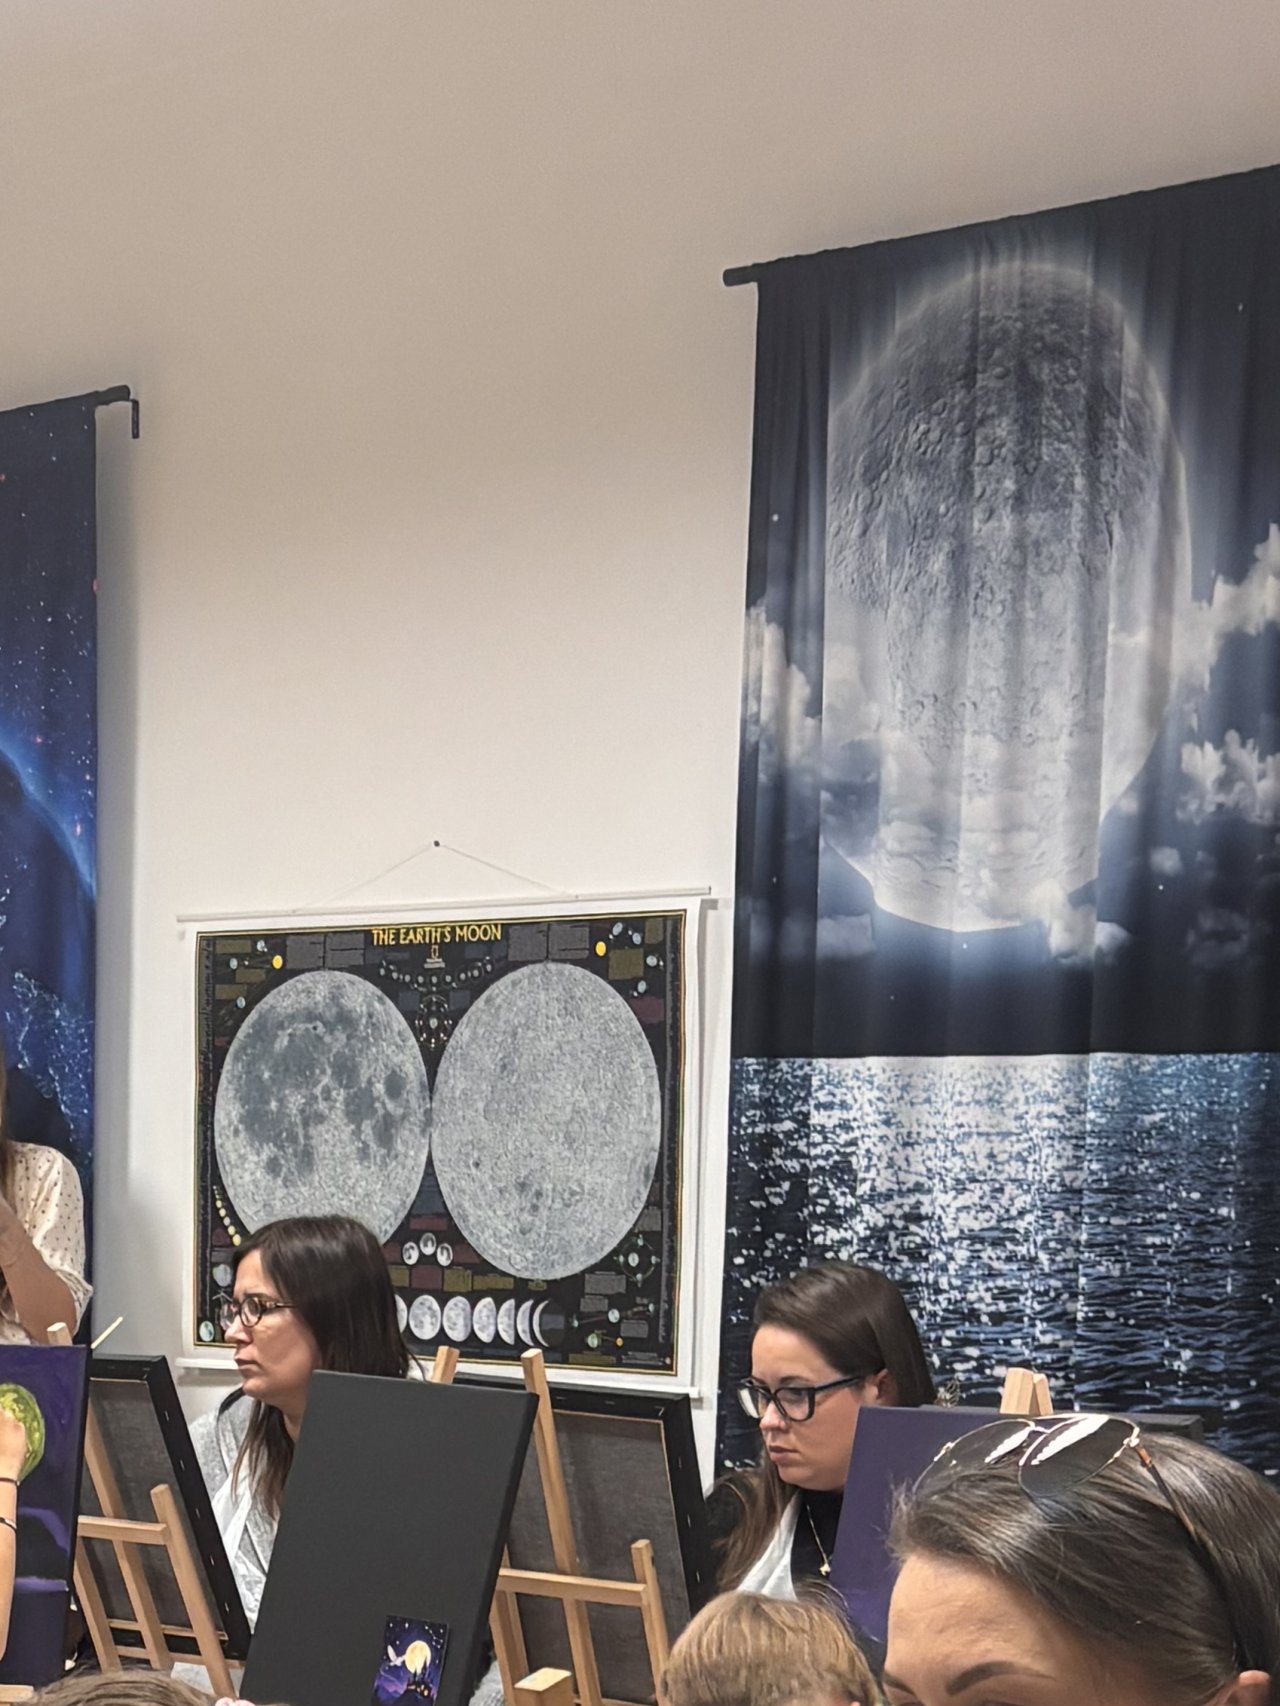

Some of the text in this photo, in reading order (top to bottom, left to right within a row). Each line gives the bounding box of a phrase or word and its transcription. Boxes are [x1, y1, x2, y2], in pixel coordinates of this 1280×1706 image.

[372, 927, 396, 946] THE
[399, 926, 451, 944] EARTH'S
[455, 923, 502, 943] MOON
